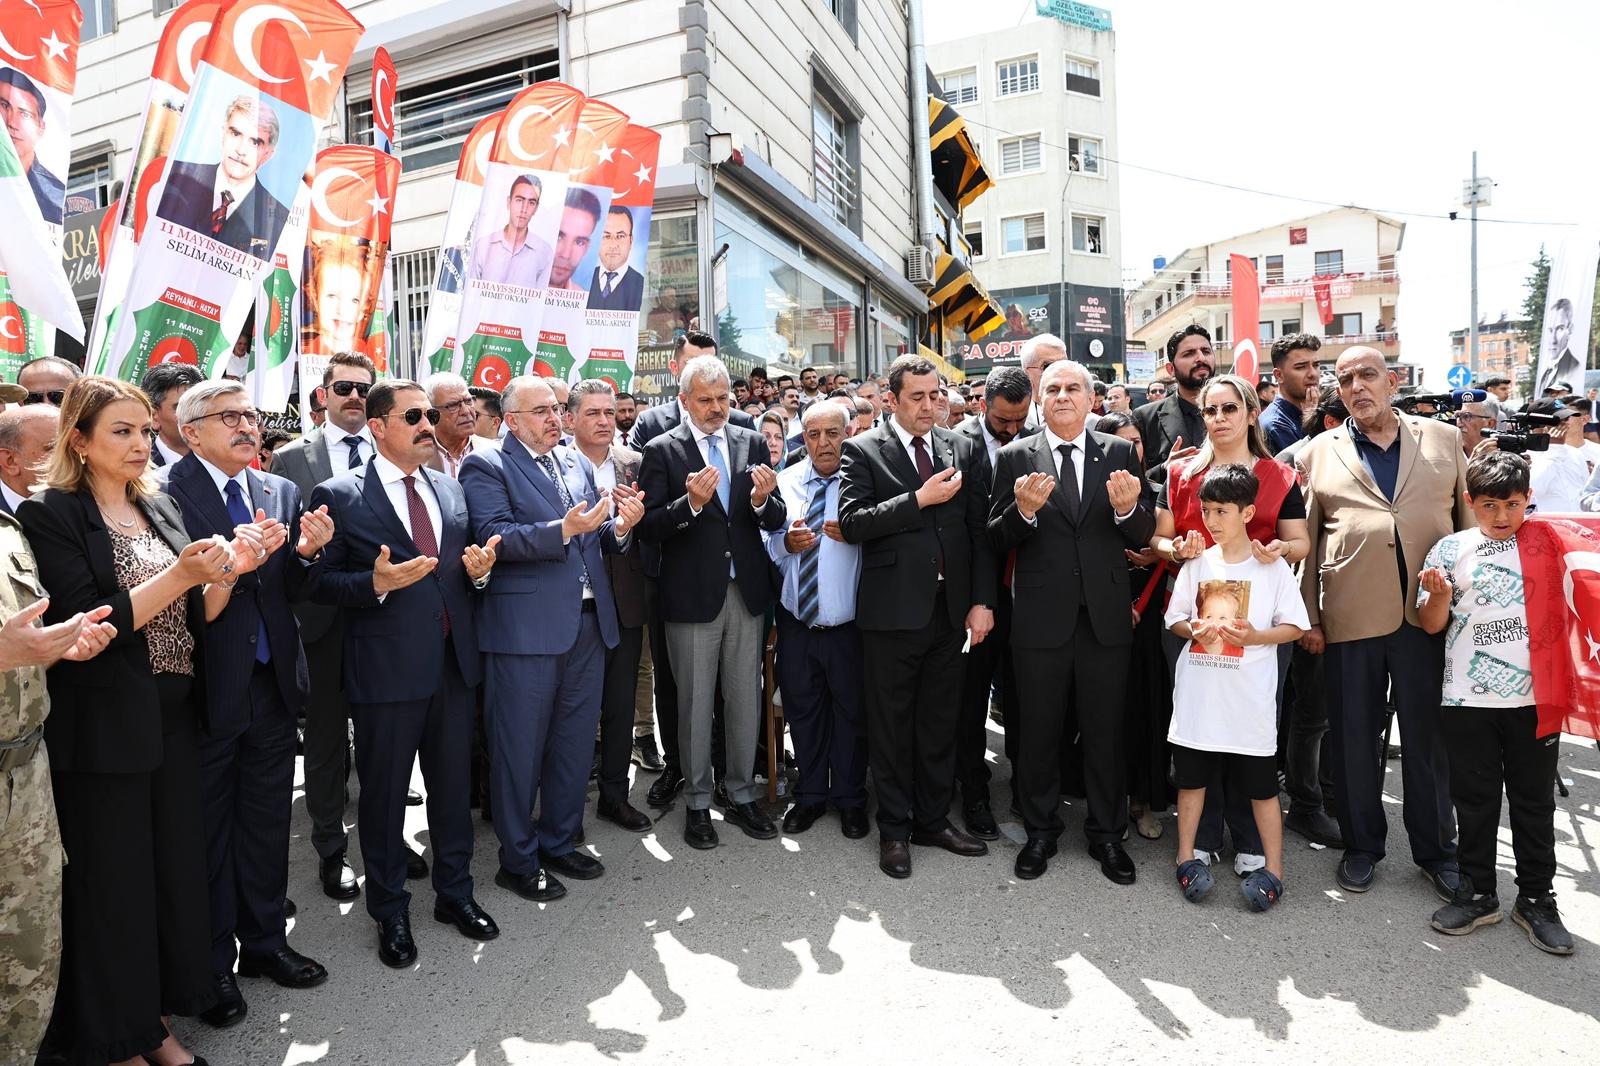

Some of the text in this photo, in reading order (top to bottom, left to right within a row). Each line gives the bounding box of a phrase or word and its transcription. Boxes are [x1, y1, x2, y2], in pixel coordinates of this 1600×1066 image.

[160, 222, 174, 235] 11
[177, 228, 215, 252] MAYIS
[166, 238, 255, 281] SELİM ARSLAN
[480, 290, 529, 304] AHMET OKYAY
[481, 281, 508, 293] MAYIS
[164, 290, 197, 308] REYHANLI
[199, 303, 219, 316] HATAY
[165, 318, 204, 336] 11 MAYIS
[489, 344, 512, 354] MAYIS
[637, 349, 676, 371] EREKET
[1473, 616, 1521, 634] FUNDAY
[1468, 669, 1513, 698] BEACH
[1473, 657, 1532, 695] VIBES
